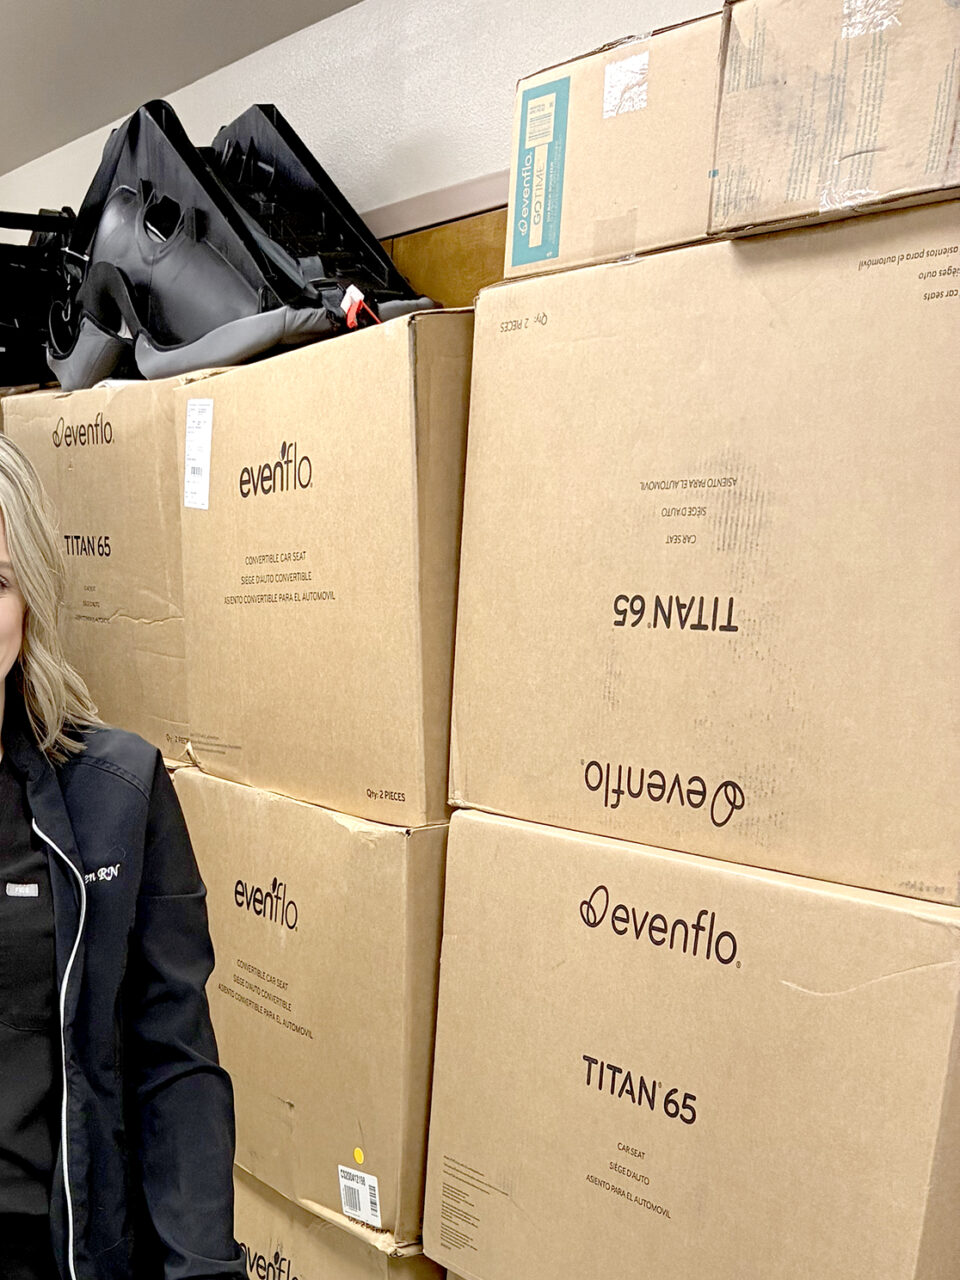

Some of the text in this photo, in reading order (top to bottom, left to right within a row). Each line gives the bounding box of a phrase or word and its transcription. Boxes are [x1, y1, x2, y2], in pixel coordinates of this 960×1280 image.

[520, 152, 533, 218] evenflo
[938, 266, 960, 278] ièges
[65, 412, 113, 446] evenflo
[240, 442, 312, 498] evenflo
[64, 535, 111, 557] TITAN 65
[666, 535, 696, 544] CAR SEAT
[280, 552, 292, 563] CAR
[293, 551, 306, 561] SEAT
[613, 595, 739, 632] TITAN 65
[385, 790, 406, 802] PIECES
[585, 760, 707, 809] evenflo
[98, 864, 120, 881] RN
[234, 880, 298, 930] evenflo
[612, 904, 737, 965] evenflo
[583, 1055, 697, 1125] TITAN 65
[617, 1142, 646, 1160] CAR SEAT
[586, 1175, 610, 1190] ASIENTO
